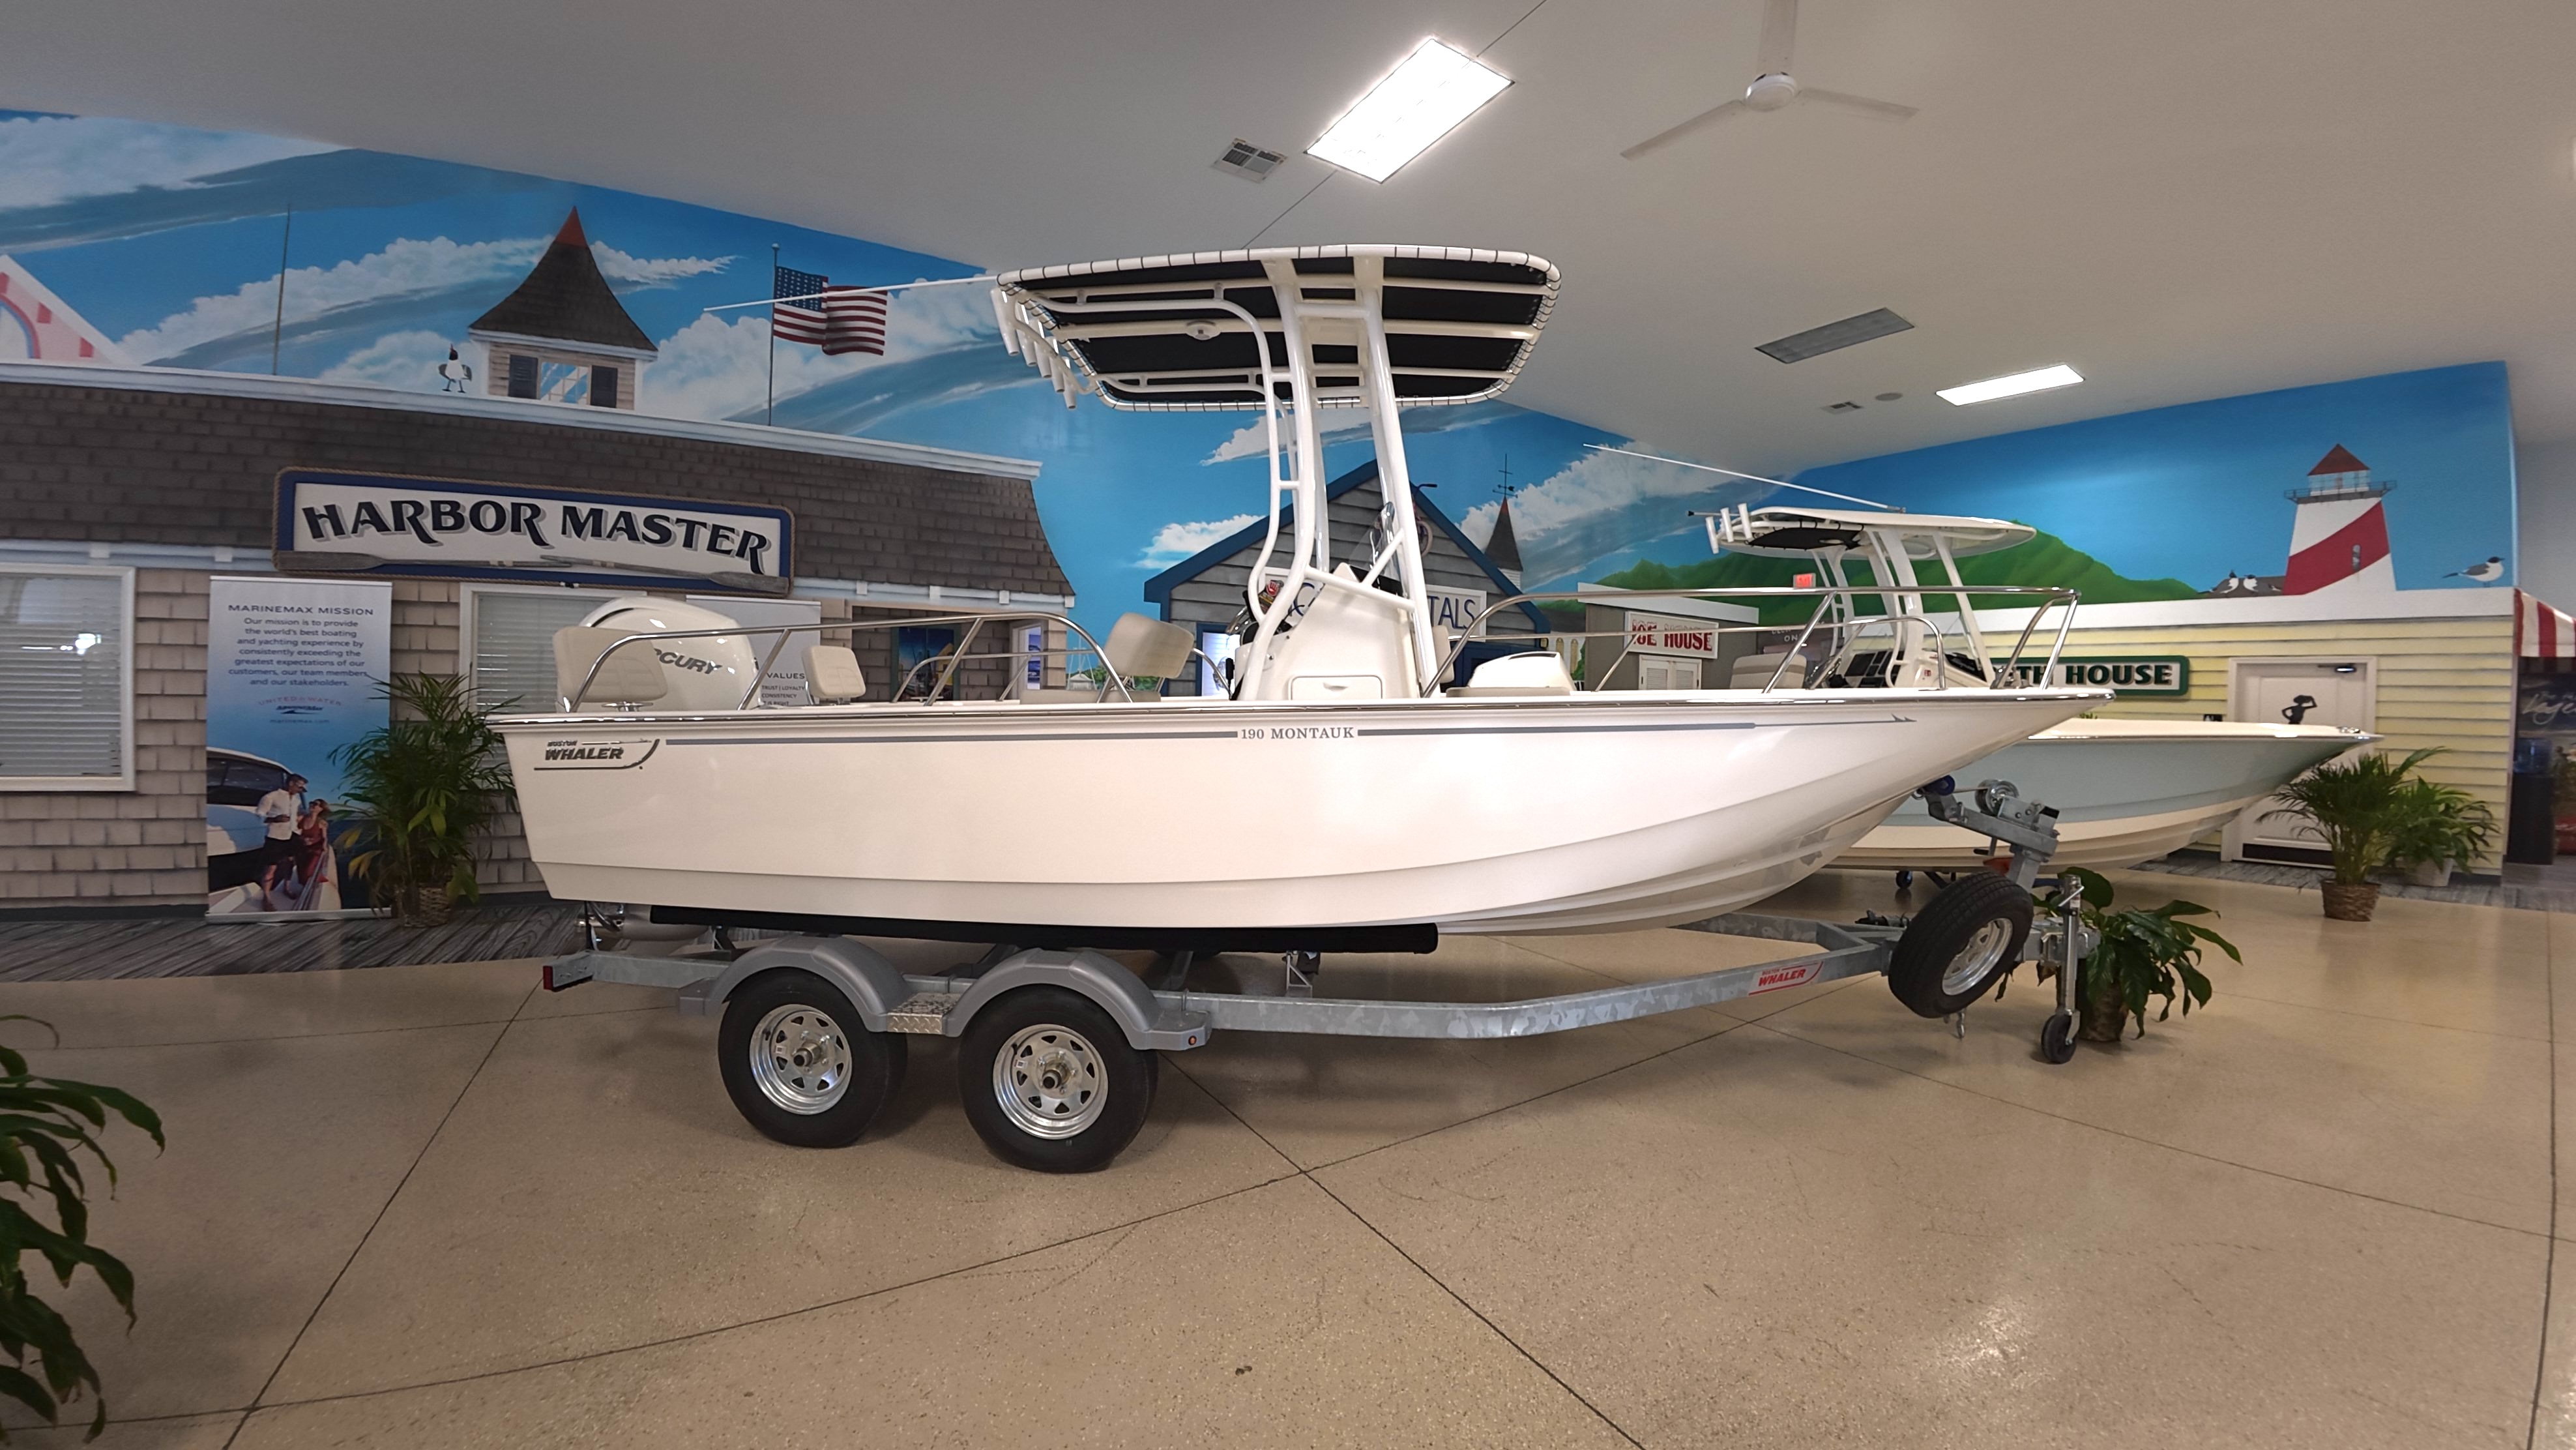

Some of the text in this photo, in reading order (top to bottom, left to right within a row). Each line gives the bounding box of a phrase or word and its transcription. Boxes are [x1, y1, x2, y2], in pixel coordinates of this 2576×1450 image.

[302, 499, 771, 574] HARBOR MASTER
[228, 604, 373, 615] MARINEMAX MISSION
[1427, 595, 1476, 630] TALS
[321, 630, 357, 638] boating
[1663, 623, 1713, 651] HOUSE
[258, 638, 299, 647] yachting
[301, 640, 350, 648] experience
[353, 640, 364, 649] by
[239, 648, 295, 657] consistently
[297, 649, 343, 658] exceeding
[654, 647, 723, 675] CURY
[2065, 664, 2173, 686] HOUSE
[308, 696, 342, 706] WATER
[1241, 727, 1354, 739] 190 MONTAUK
[545, 747, 624, 761] WHALER
[1758, 968, 1807, 987] WHALER
